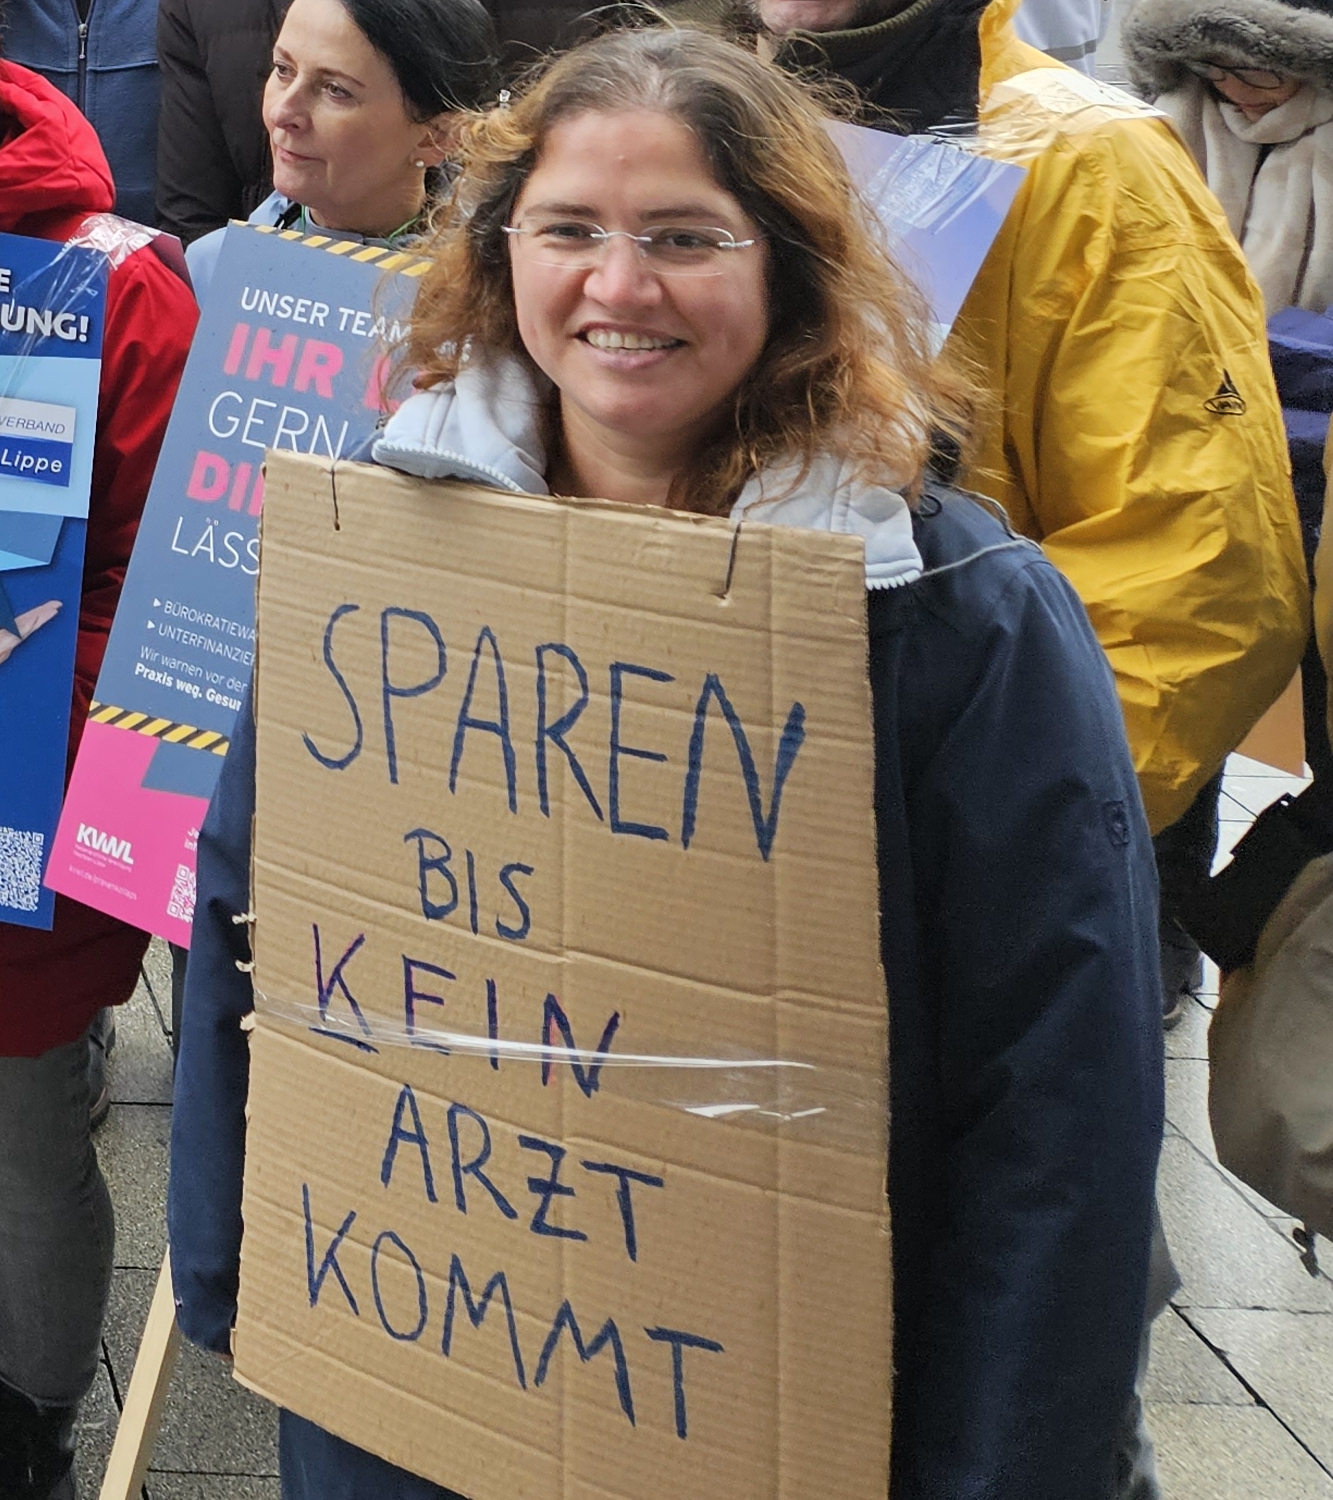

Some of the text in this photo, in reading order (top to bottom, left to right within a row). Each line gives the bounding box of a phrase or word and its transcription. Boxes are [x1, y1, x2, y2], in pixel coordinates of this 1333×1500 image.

[223, 322, 344, 398] IHR
[241, 287, 330, 327] UNSER
[302, 603, 806, 863] SPAREN
[77, 822, 134, 864] KVWL
[404, 827, 534, 940] BIS
[313, 924, 621, 1099] KEIN
[380, 1083, 664, 1262] ARZT
[302, 1183, 726, 1439] KOMMT
